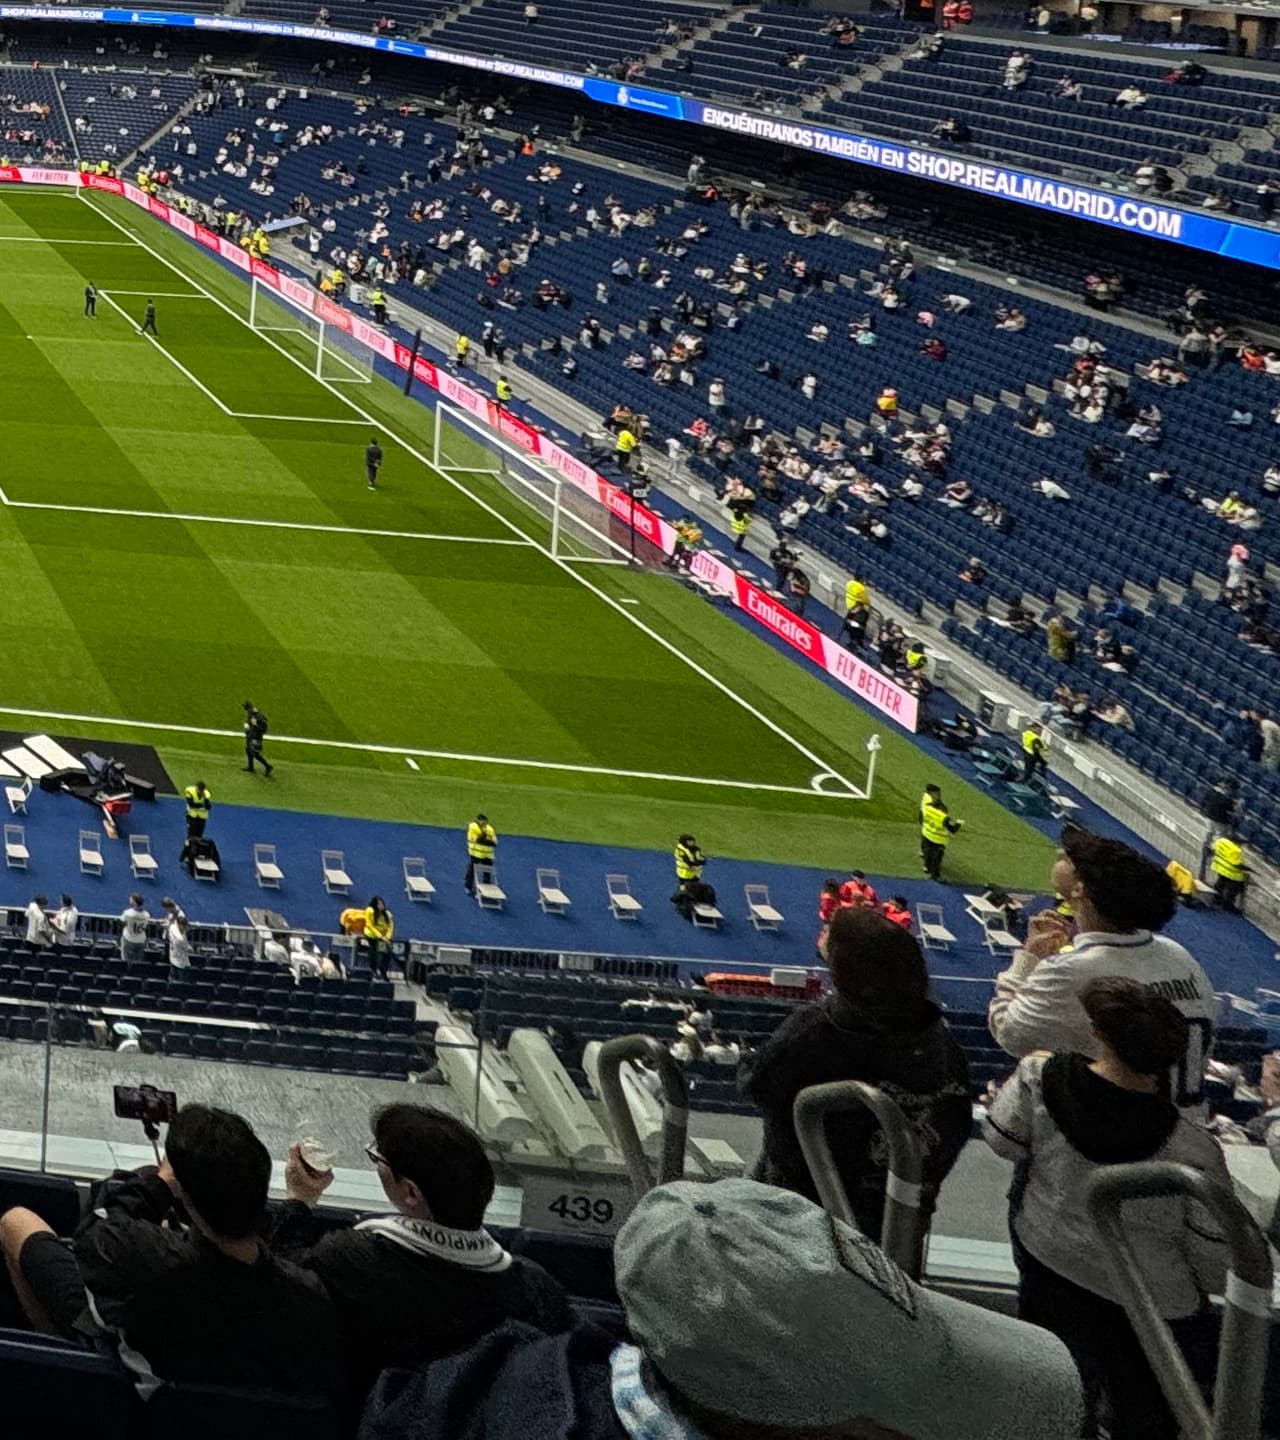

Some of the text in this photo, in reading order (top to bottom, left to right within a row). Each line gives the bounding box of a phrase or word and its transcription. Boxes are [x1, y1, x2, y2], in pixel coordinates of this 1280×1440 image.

[703, 107, 1182, 239] ENCUÉNTRANOS TAMBIÉN EN SHOP.REALMADRID.COM
[747, 589, 812, 650] Emirates
[836, 652, 902, 715] FLY BETTER
[548, 1194, 613, 1224] 439
